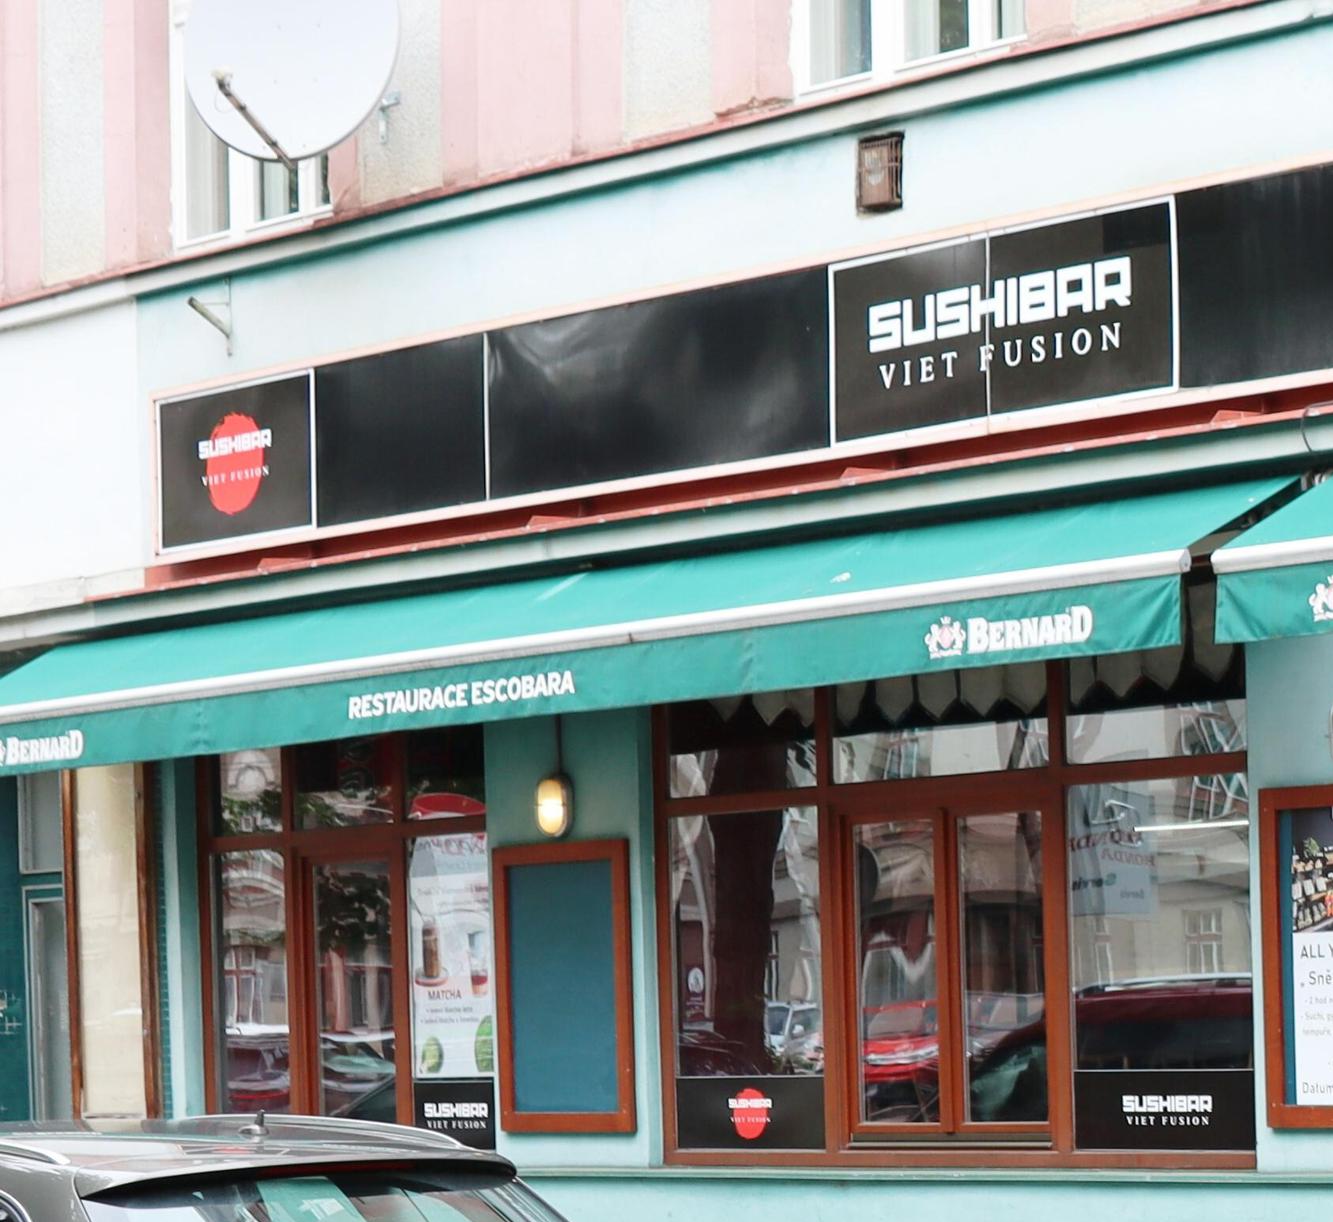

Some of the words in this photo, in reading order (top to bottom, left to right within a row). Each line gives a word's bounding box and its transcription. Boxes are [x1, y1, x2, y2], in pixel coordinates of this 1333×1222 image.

[867, 256, 1132, 353] SUSHIBAR
[878, 350, 959, 390] VIET
[980, 321, 1124, 374] FUSION
[198, 428, 272, 460] SUSHIBAR
[201, 472, 226, 487] VIET
[229, 464, 270, 482] FUSION
[966, 605, 1093, 654] BERNARD
[348, 682, 468, 720] RESTAURACE
[471, 671, 576, 706] ESCOBARA
[5, 729, 84, 766] BERNARD
[1300, 944, 1325, 959] ALL
[427, 989, 462, 1001] MATCHA
[424, 1101, 489, 1119] SUSHIBAR
[1122, 1095, 1213, 1113] SUSHIBAR
[427, 1119, 447, 1130] VIET
[452, 1118, 487, 1130] FUSION
[1126, 1115, 1155, 1126] VIET
[1161, 1115, 1210, 1126] FUSION
